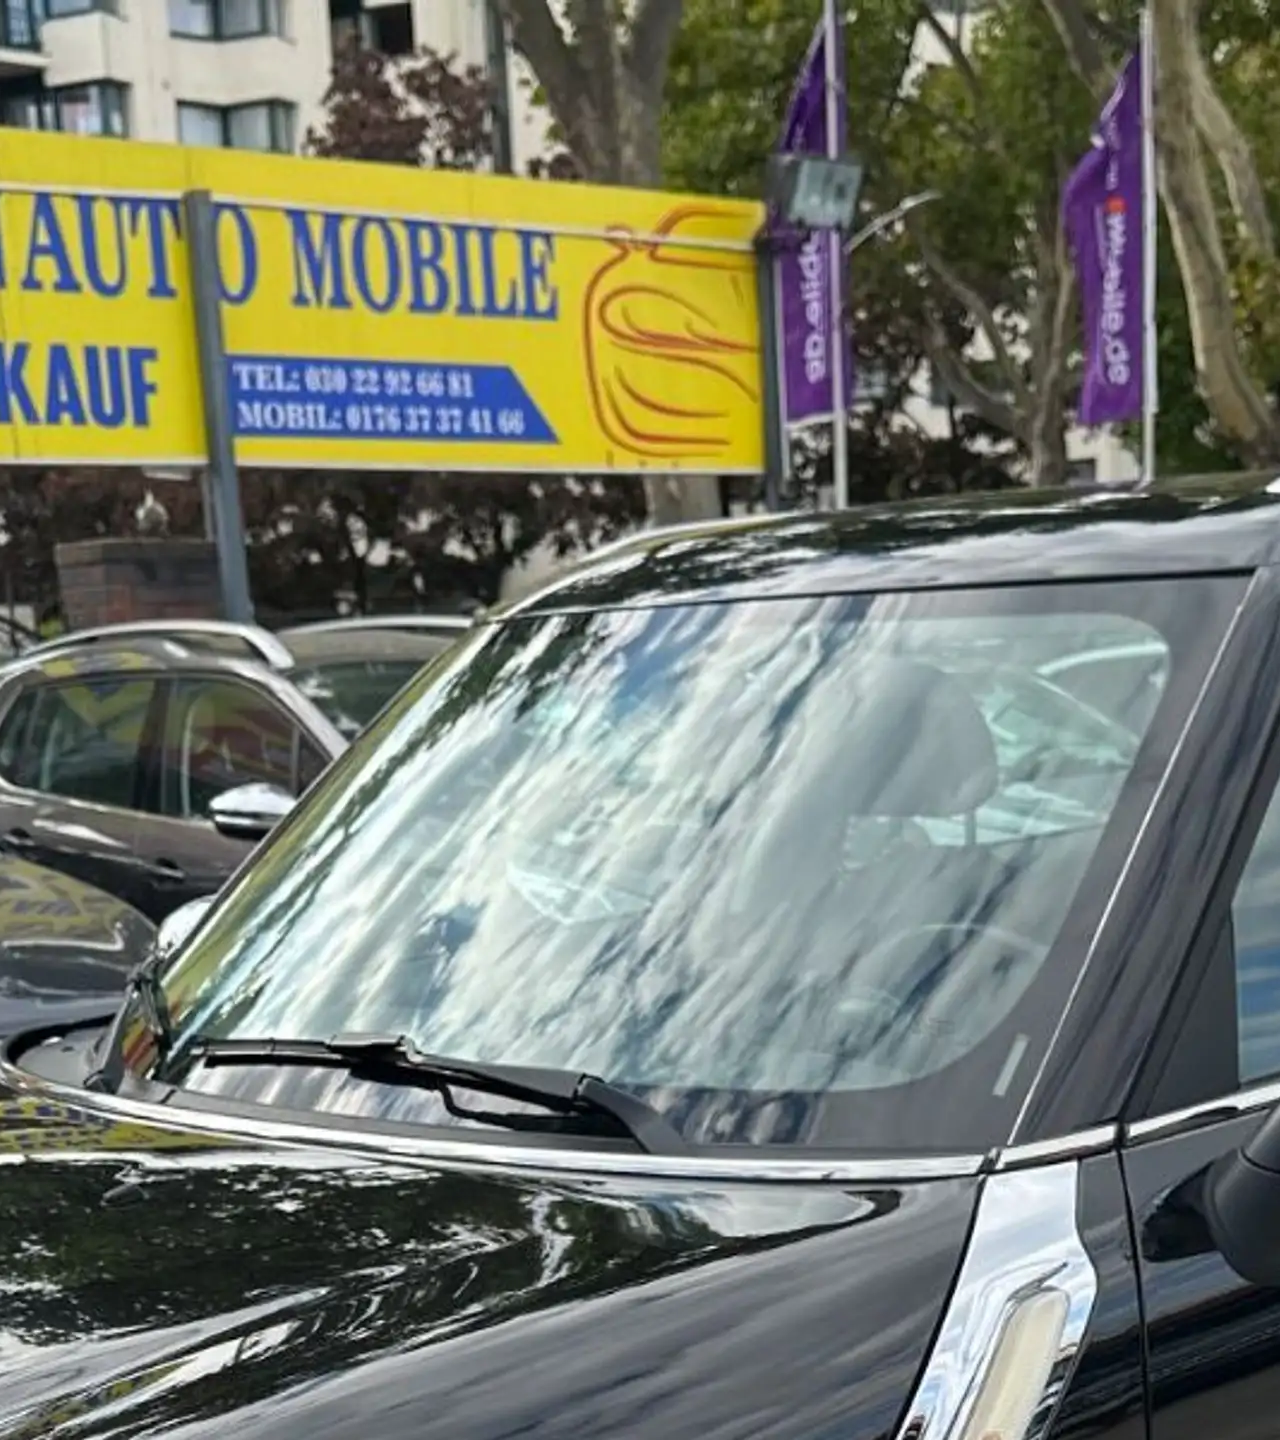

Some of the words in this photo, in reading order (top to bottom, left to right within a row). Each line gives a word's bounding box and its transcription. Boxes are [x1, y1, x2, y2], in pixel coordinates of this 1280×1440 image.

[284, 209, 559, 319] MOBILE
[232, 361, 300, 392] TEL:
[304, 365, 347, 395] 030
[350, 367, 380, 396] 22
[383, 368, 413, 398] 92
[237, 400, 343, 431] MOBIL:
[345, 403, 401, 433] 0176
[404, 406, 431, 434] 37
[435, 407, 463, 435] 37
[468, 408, 493, 435] 41
